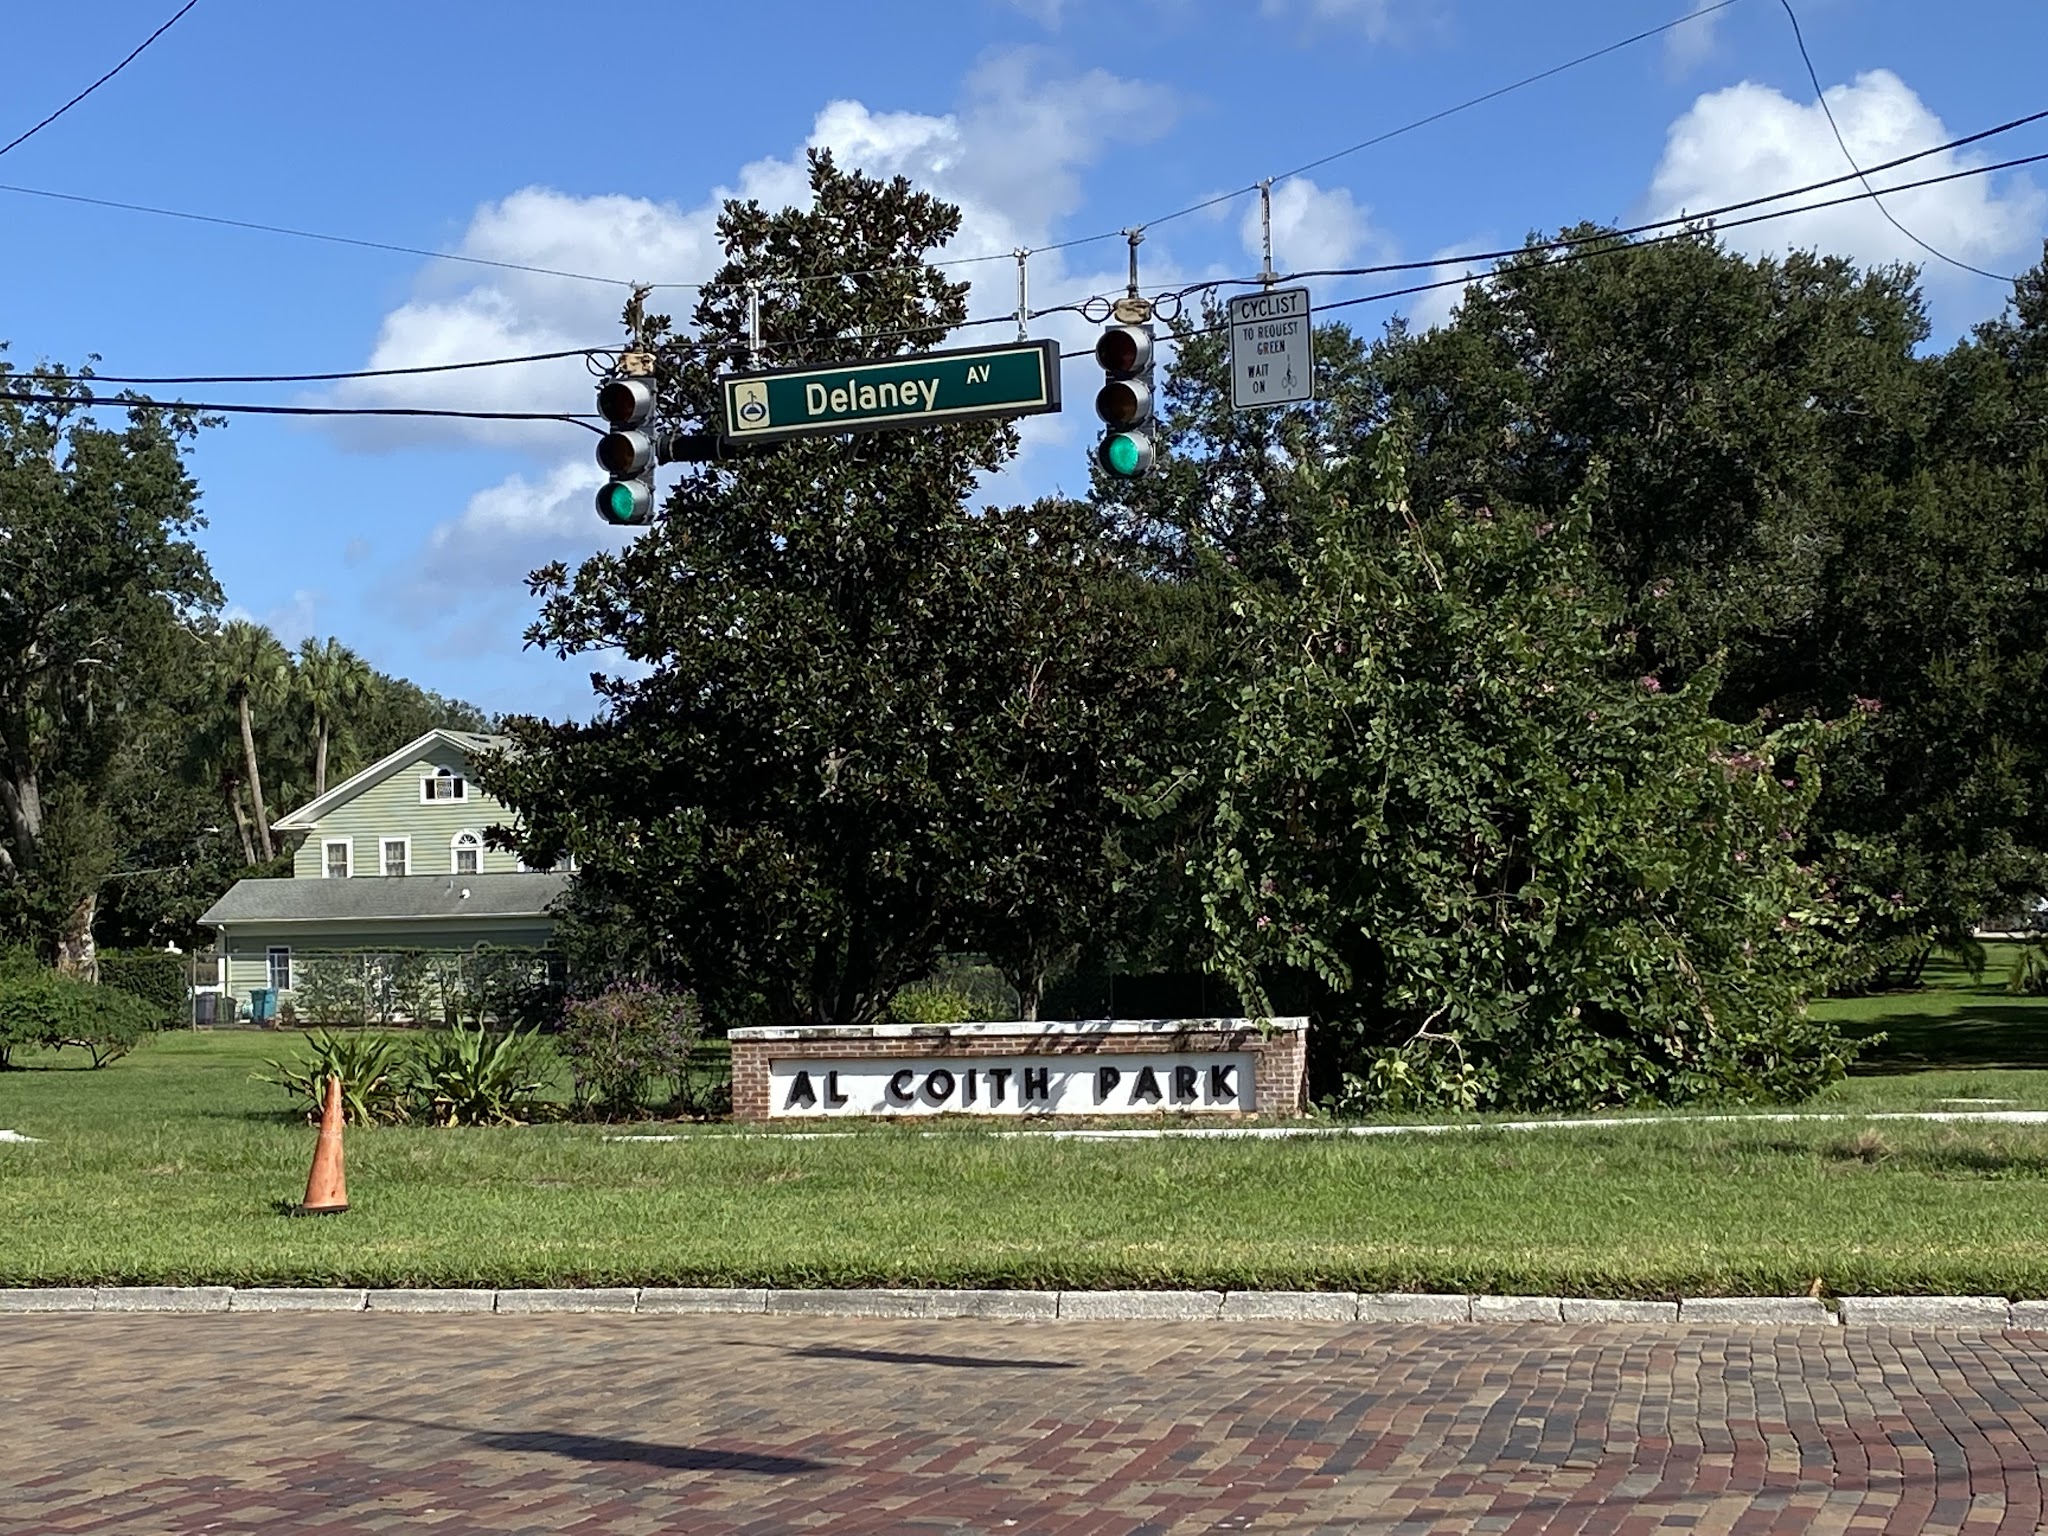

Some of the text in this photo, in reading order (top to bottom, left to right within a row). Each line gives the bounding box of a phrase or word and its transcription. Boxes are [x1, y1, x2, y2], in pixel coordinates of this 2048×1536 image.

[1241, 294, 1297, 319] CYCLIST
[1243, 321, 1299, 341] TO REQUEST
[1257, 340, 1286, 355] GREEN
[1247, 363, 1269, 378] WAIT
[806, 364, 991, 416] Delaney AV
[1252, 381, 1266, 394] ON
[791, 1065, 1239, 1102] AL COITH PARK
